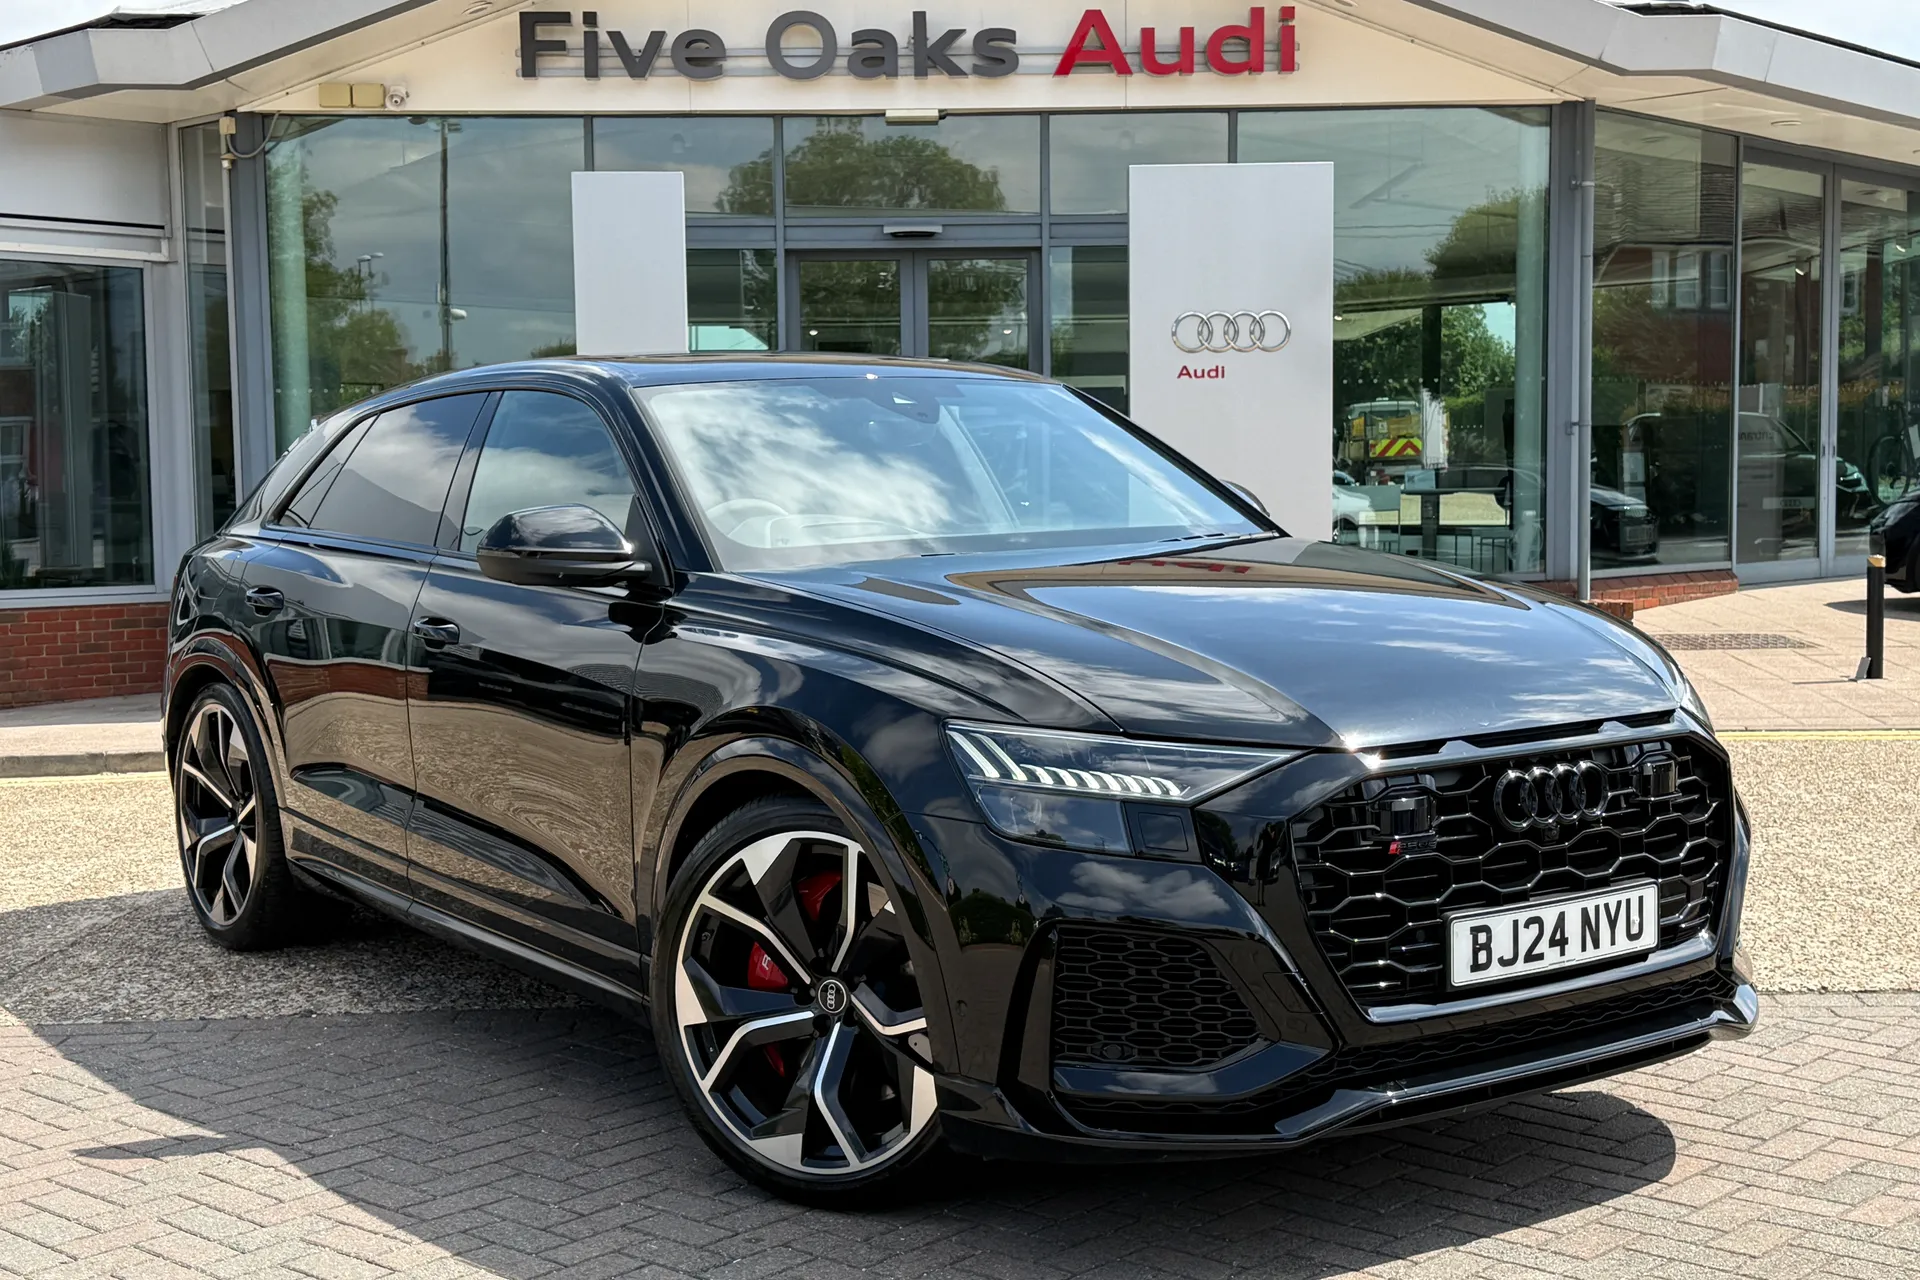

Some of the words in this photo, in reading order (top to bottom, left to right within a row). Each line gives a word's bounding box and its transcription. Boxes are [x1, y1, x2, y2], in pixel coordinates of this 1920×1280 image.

[519, 11, 727, 81] Five
[765, 10, 1020, 80] Oaks
[1052, 6, 1296, 77] Audi
[1176, 365, 1226, 379] Audi
[1469, 910, 1569, 974] BJ24
[1580, 895, 1644, 953] NYU
